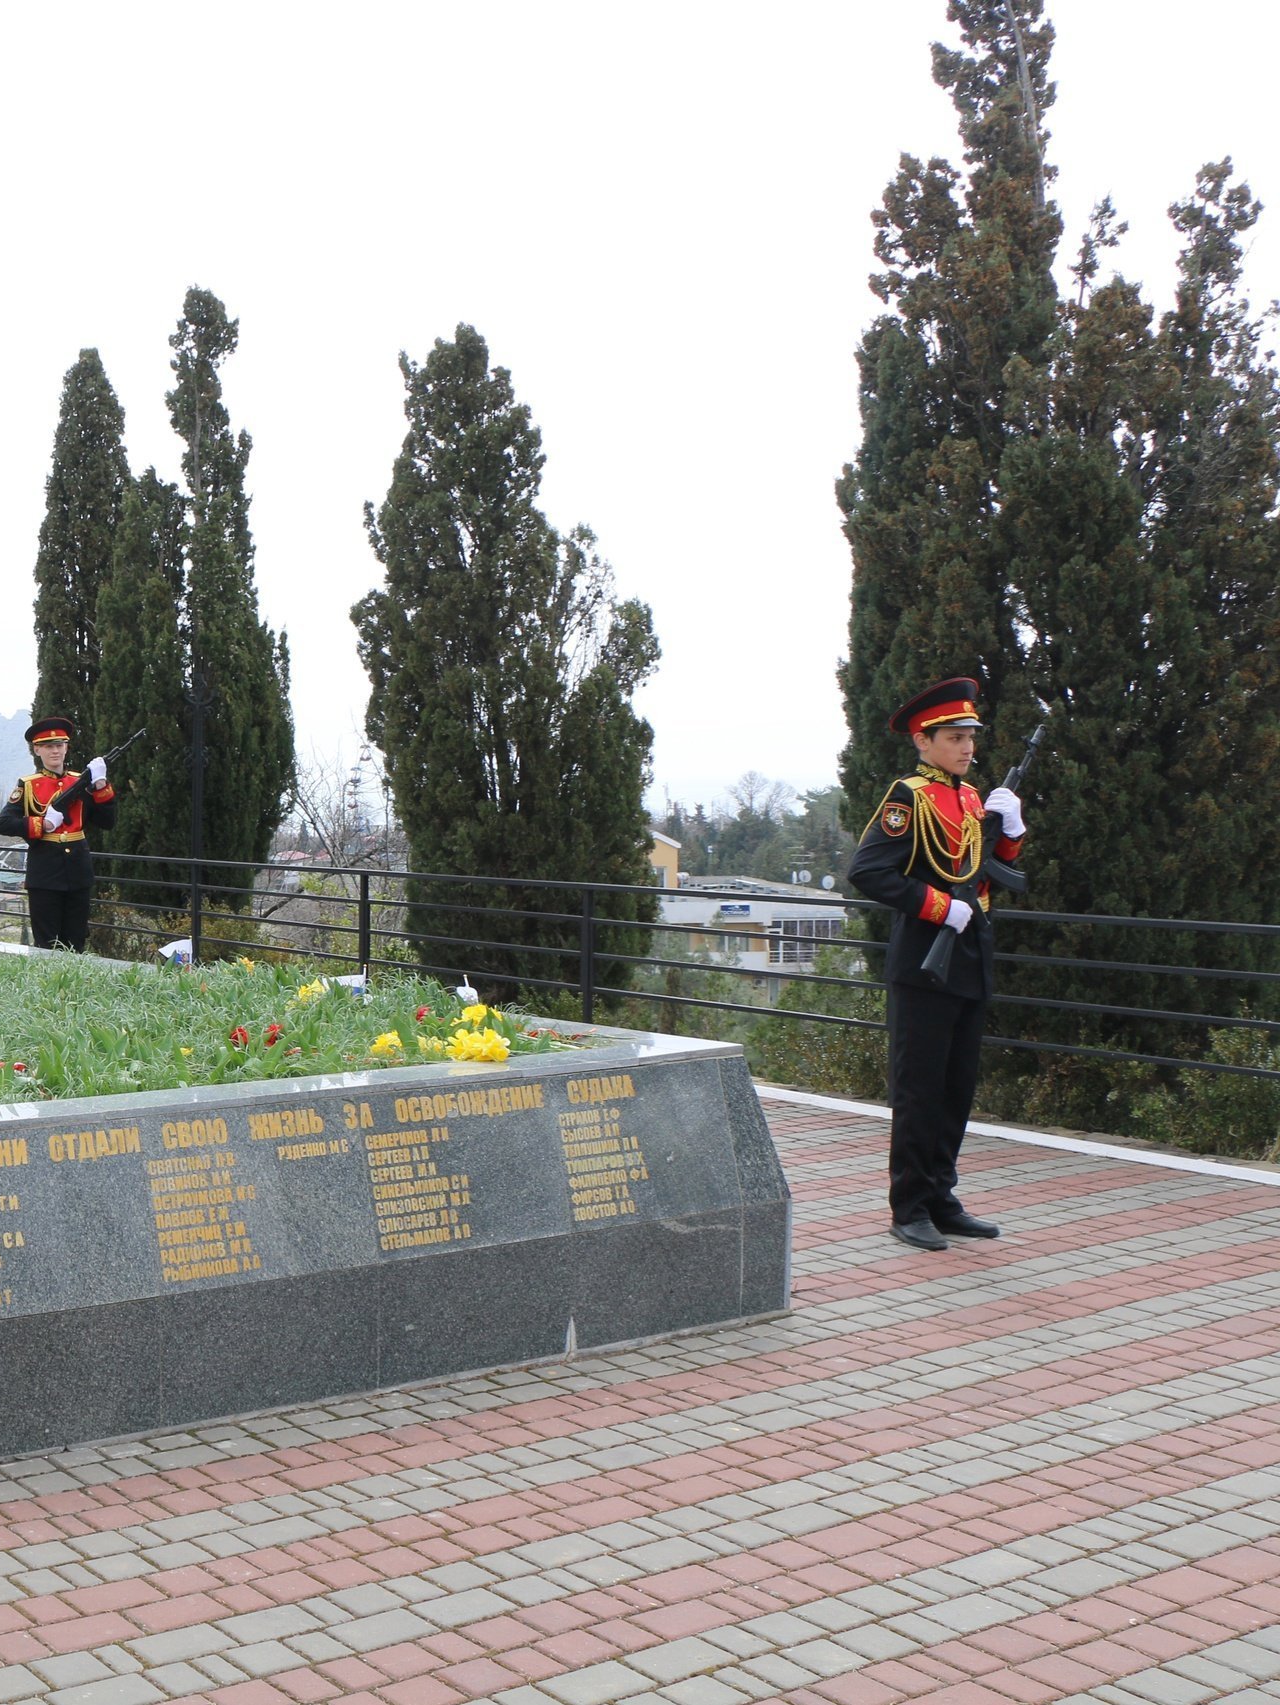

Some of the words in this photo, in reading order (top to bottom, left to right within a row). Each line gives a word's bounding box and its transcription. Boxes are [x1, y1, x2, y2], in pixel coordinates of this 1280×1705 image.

[48, 1126, 142, 1163] ОТДАЛИ
[162, 1118, 228, 1150] СВОЮ
[249, 1108, 323, 1141] ЖИЗНЬ
[343, 1102, 373, 1129] ЗА
[395, 1084, 545, 1119] ОСВОБОЖДЕНИЕ
[566, 1073, 636, 1105] СУДАКА
[559, 1111, 600, 1126] СТРАХОВ
[610, 1107, 620, 1120] Ф
[561, 1127, 600, 1142] СЫСОЕВ
[278, 1144, 325, 1159] РУДЕНКО
[329, 1140, 339, 1154] М
[341, 1138, 349, 1152] С
[368, 1149, 410, 1166] СЕРГЕЕВ
[412, 1146, 421, 1161] А
[370, 1166, 413, 1182] СЕРГЕЕВ
[630, 1167, 641, 1181] Ф
[373, 1178, 449, 1200] СИНЕЛЬНИКОВ
[451, 1174, 460, 1190] С
[572, 1189, 612, 1205] ФИРСОВ
[209, 1207, 216, 1223] Е
[378, 1213, 436, 1232] СЛЮСАРЕВ
[2, 1232, 13, 1249] С
[15, 1231, 24, 1247] А
